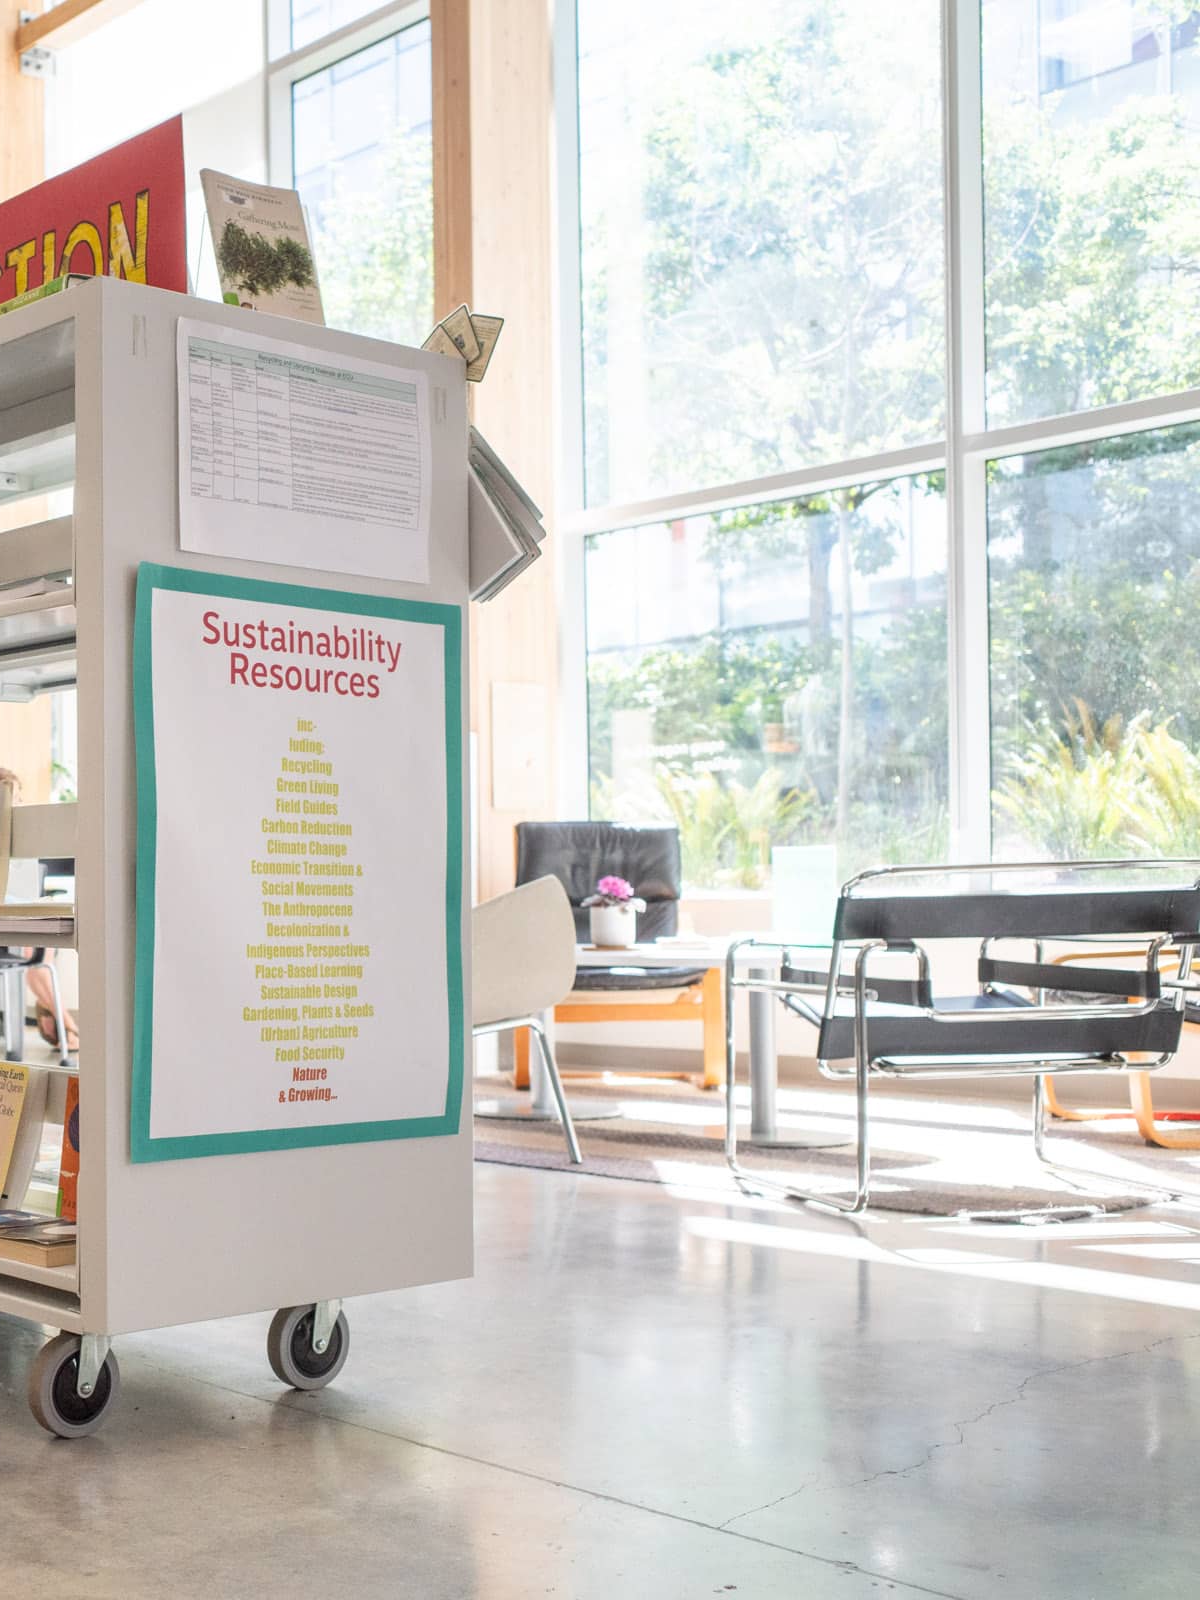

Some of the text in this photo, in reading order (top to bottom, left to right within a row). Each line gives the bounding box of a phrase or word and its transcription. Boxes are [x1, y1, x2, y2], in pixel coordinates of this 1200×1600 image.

[202, 611, 402, 673] Sustainability
[230, 652, 380, 699] Resources
[281, 757, 332, 776] Recycling
[276, 777, 339, 797] Green Living
[275, 798, 338, 815] Field Guides
[261, 818, 352, 836] Carbon Reduction
[267, 839, 347, 857] Climate Change
[251, 860, 363, 877] Economic Transition &
[261, 880, 354, 897] Social Movements
[262, 901, 353, 918] The Anthropocene
[266, 922, 350, 937] Decolonization &
[246, 943, 370, 960] Indigenous Perspectives
[255, 964, 363, 980] Place-Based Learning
[260, 983, 358, 1000] Sustainable Design
[243, 1003, 375, 1022] Gardening, Plants & Seeds
[260, 1024, 359, 1042] (Urban) Agriculture
[275, 1045, 345, 1062] Food Security
[9, 1067, 24, 1080] Earth
[292, 1067, 327, 1082] Nature
[278, 1089, 286, 1103] &
